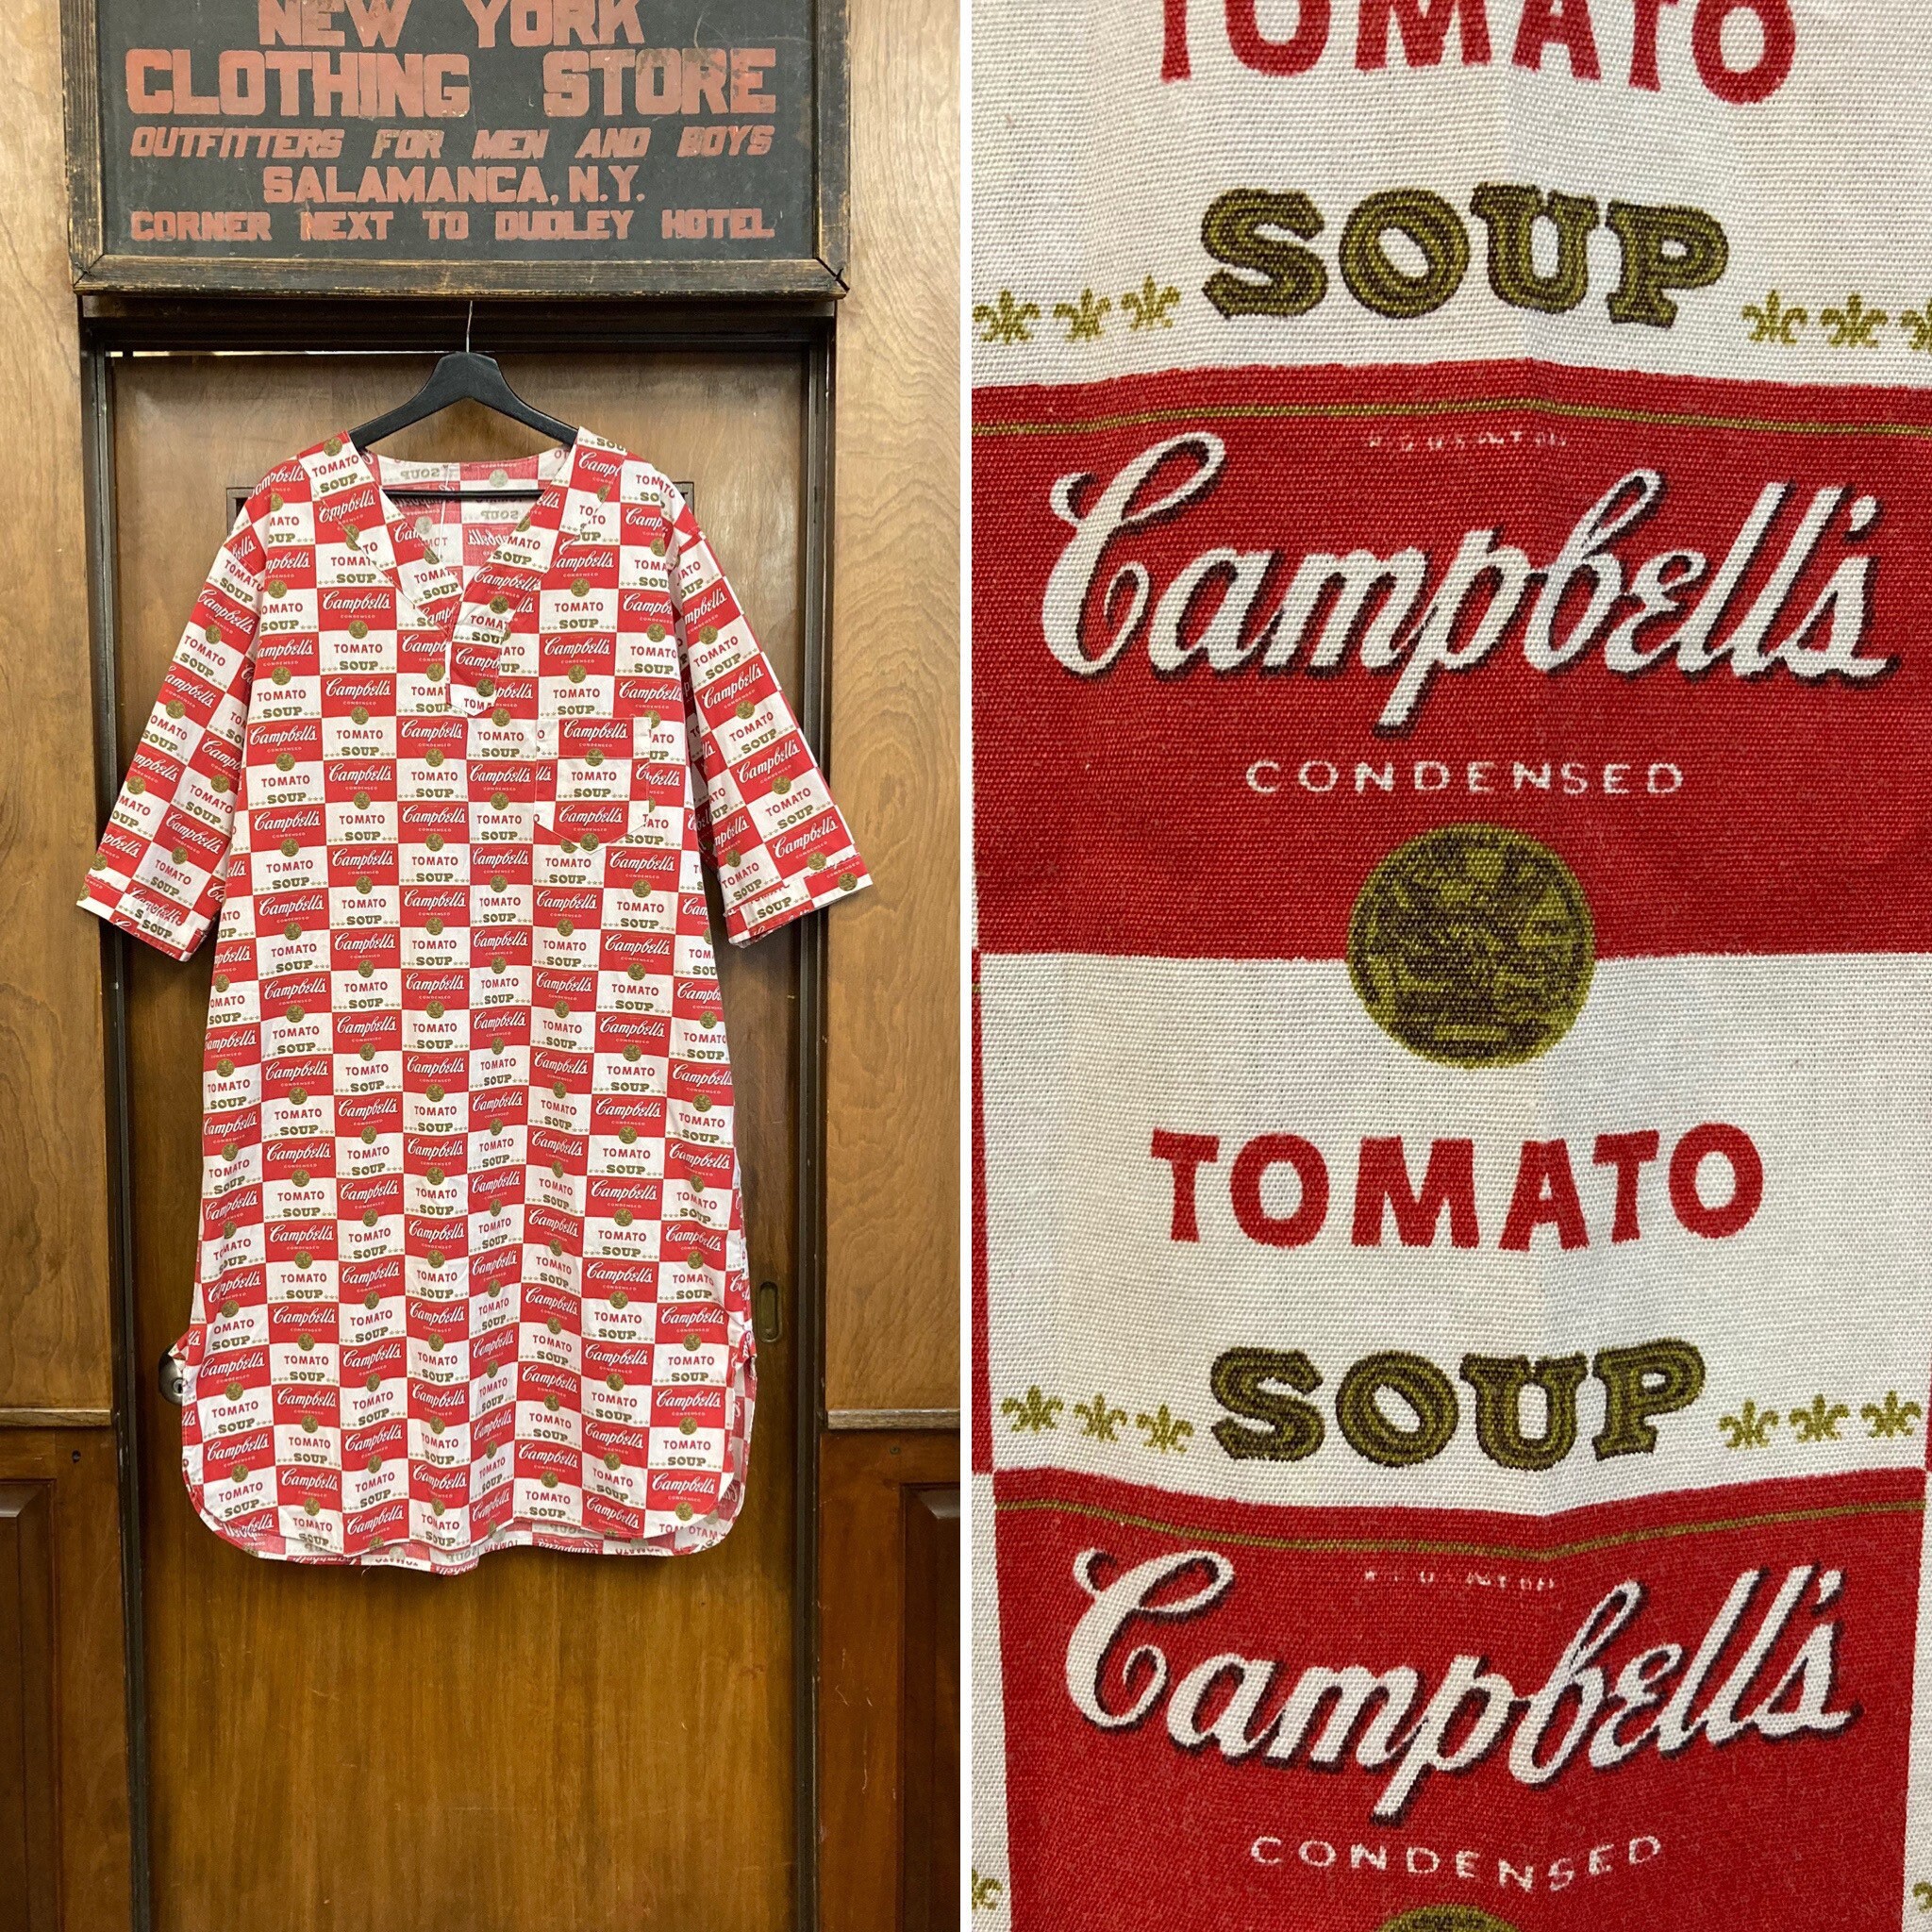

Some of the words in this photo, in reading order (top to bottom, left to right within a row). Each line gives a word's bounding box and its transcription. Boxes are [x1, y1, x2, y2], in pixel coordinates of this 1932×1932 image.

[258, 0, 411, 47] NEW
[462, 0, 644, 48] YORK
[125, 48, 470, 118] CLOTHING
[542, 48, 776, 117] STORE
[130, 126, 344, 158] OUTFITTERS
[372, 129, 444, 158] FOR
[473, 128, 549, 158] MEN
[575, 127, 652, 158] AND
[677, 125, 775, 158] BOYS
[263, 166, 558, 206] SALAMANCA,
[569, 165, 645, 203] N.Y.
[131, 210, 272, 242] CORNER
[300, 210, 393, 241] NEXT
[423, 210, 469, 241] TO
[495, 209, 634, 241] DUDLEY
[661, 208, 775, 240] HOTEL
[1201, 183, 1728, 327] SOUP
[312, 455, 359, 477] TOMATO
[319, 474, 358, 492] SOUP
[492, 551, 531, 565] SOUP
[337, 574, 376, 584] SOUP
[474, 566, 540, 591] Campbell's
[1042, 430, 1898, 740] Campbell's
[220, 576, 253, 604] SOUP
[322, 591, 391, 609] Campbell's
[555, 602, 604, 612] TOMATO
[199, 589, 255, 635] Campbell's
[558, 620, 598, 629] SOUP
[184, 635, 226, 667] TOMATO
[334, 643, 383, 654] TOMATO
[544, 637, 610, 656] Campbell's
[630, 646, 676, 658] TOMATO
[693, 636, 739, 667] TOMATO
[179, 653, 214, 676] SOUP
[340, 660, 378, 671] SOUP
[634, 663, 674, 675] SOUP
[705, 653, 741, 679] SOUP
[325, 677, 391, 697] Campbell's
[553, 689, 600, 699] TOMATO
[619, 681, 682, 702] Campbell's
[702, 664, 765, 708] Campbell's
[257, 690, 307, 701] TOMATO
[262, 707, 302, 718] SOUP
[558, 706, 595, 715] SOUP
[337, 730, 383, 739] TOMATO
[564, 720, 627, 741] Campbell's
[729, 711, 774, 741] TOMATO
[250, 726, 317, 746] Campbell's
[478, 732, 524, 741] TOMATO
[741, 729, 776, 754] SOUP
[341, 747, 379, 756] SOUP
[481, 748, 520, 758] SOUP
[738, 738, 801, 783] Campbell's
[261, 775, 310, 788] TOMATO
[1245, 760, 1684, 794] CONDENSED
[190, 784, 234, 814] TOMATO
[267, 792, 307, 805] SOUP
[765, 787, 812, 817] TOMATO
[186, 802, 222, 827] SOUP
[402, 805, 466, 825] Campbell's
[477, 815, 522, 824] TOMATO
[777, 805, 814, 829] SOUP
[165, 811, 222, 856] Campbell's
[481, 831, 518, 841] SOUP
[774, 821, 840, 858] Campbell's
[332, 849, 393, 870] Campbell's
[412, 857, 458, 866] TOMATO
[609, 851, 675, 873] Campbell's
[155, 858, 192, 885] TOMATO
[416, 874, 453, 882] SOUP
[721, 861, 759, 889] TOMATO
[151, 875, 179, 897] SOUP
[733, 879, 762, 901] SOUP
[259, 895, 324, 916] Campbell's
[342, 899, 387, 909] TOMATO
[480, 897, 521, 907] TOMATO
[617, 901, 664, 913] TOMATO
[757, 897, 792, 919] SOUP
[347, 915, 382, 925] SOUP
[483, 913, 516, 923] SOUP
[142, 919, 173, 940] SOUP
[334, 933, 395, 953] Campbell's
[412, 941, 457, 949] TOMATO
[605, 935, 670, 956] Campbell's
[276, 960, 313, 973] SOUP
[264, 978, 326, 1000] Campbell's
[481, 978, 519, 988] TOMATO
[536, 972, 591, 992] Campbell's
[611, 984, 658, 995] TOMATO
[349, 998, 383, 1008] SOUP
[484, 994, 514, 1004] SOUP
[615, 1000, 654, 1011] SOUP
[273, 1026, 320, 1039] TOMATO
[600, 1016, 665, 1037] Campbell's
[277, 1043, 316, 1054] SOUP
[345, 1064, 389, 1075] TOMATO
[338, 1098, 398, 1120] Campbell's
[541, 1100, 576, 1115] TOMATO
[682, 1129, 720, 1143] SOUP
[266, 1142, 331, 1161] Campbell's
[347, 1146, 390, 1158] TOMATO
[603, 1148, 651, 1158] TOMATO
[669, 1142, 730, 1170] Campbell's
[208, 1159, 250, 1177] TOMATO
[351, 1163, 386, 1175] SOUP
[607, 1164, 645, 1174] SOUP
[277, 1191, 325, 1201] TOMATO
[591, 1180, 658, 1200] Campbell's
[1151, 1123, 1763, 1251] TOMATO
[676, 1192, 717, 1209] TOMATO
[283, 1208, 320, 1217] SOUP
[270, 1224, 334, 1245] Campbell's
[478, 1218, 511, 1233] TOMATO
[598, 1230, 646, 1241] TOMATO
[602, 1246, 641, 1257] SOUP
[473, 1251, 517, 1274] Campbell's
[281, 1274, 327, 1283] TOMATO
[586, 1261, 653, 1283] Campbell's
[661, 1307, 724, 1324] Campbell's
[342, 1345, 402, 1368] Campbell's
[417, 1352, 458, 1364] TOMATO
[200, 1354, 264, 1378] Campbell's
[290, 1372, 325, 1382] SOUP
[422, 1369, 454, 1382] SOUP
[522, 1364, 577, 1394] Campbell's
[276, 1386, 336, 1408] Campbell's
[353, 1391, 393, 1410] TOMATO
[411, 1383, 465, 1407] Campbell's
[591, 1392, 638, 1407] TOMATO
[1209, 1338, 1706, 1470] SOUP
[529, 1412, 572, 1429] TOMATO
[595, 1408, 632, 1423] SOUP
[289, 1437, 331, 1449] TOMATO
[663, 1440, 710, 1451] TOMATO
[668, 1457, 706, 1467] SOUP
[219, 1482, 263, 1502] TOMATO
[652, 1473, 715, 1495] Campbell's
[225, 1500, 259, 1518] SOUP
[529, 1507, 566, 1519] SOUP
[1064, 1547, 1863, 1824] Campbell's
[1251, 1834, 1661, 1891] CONDENSED
